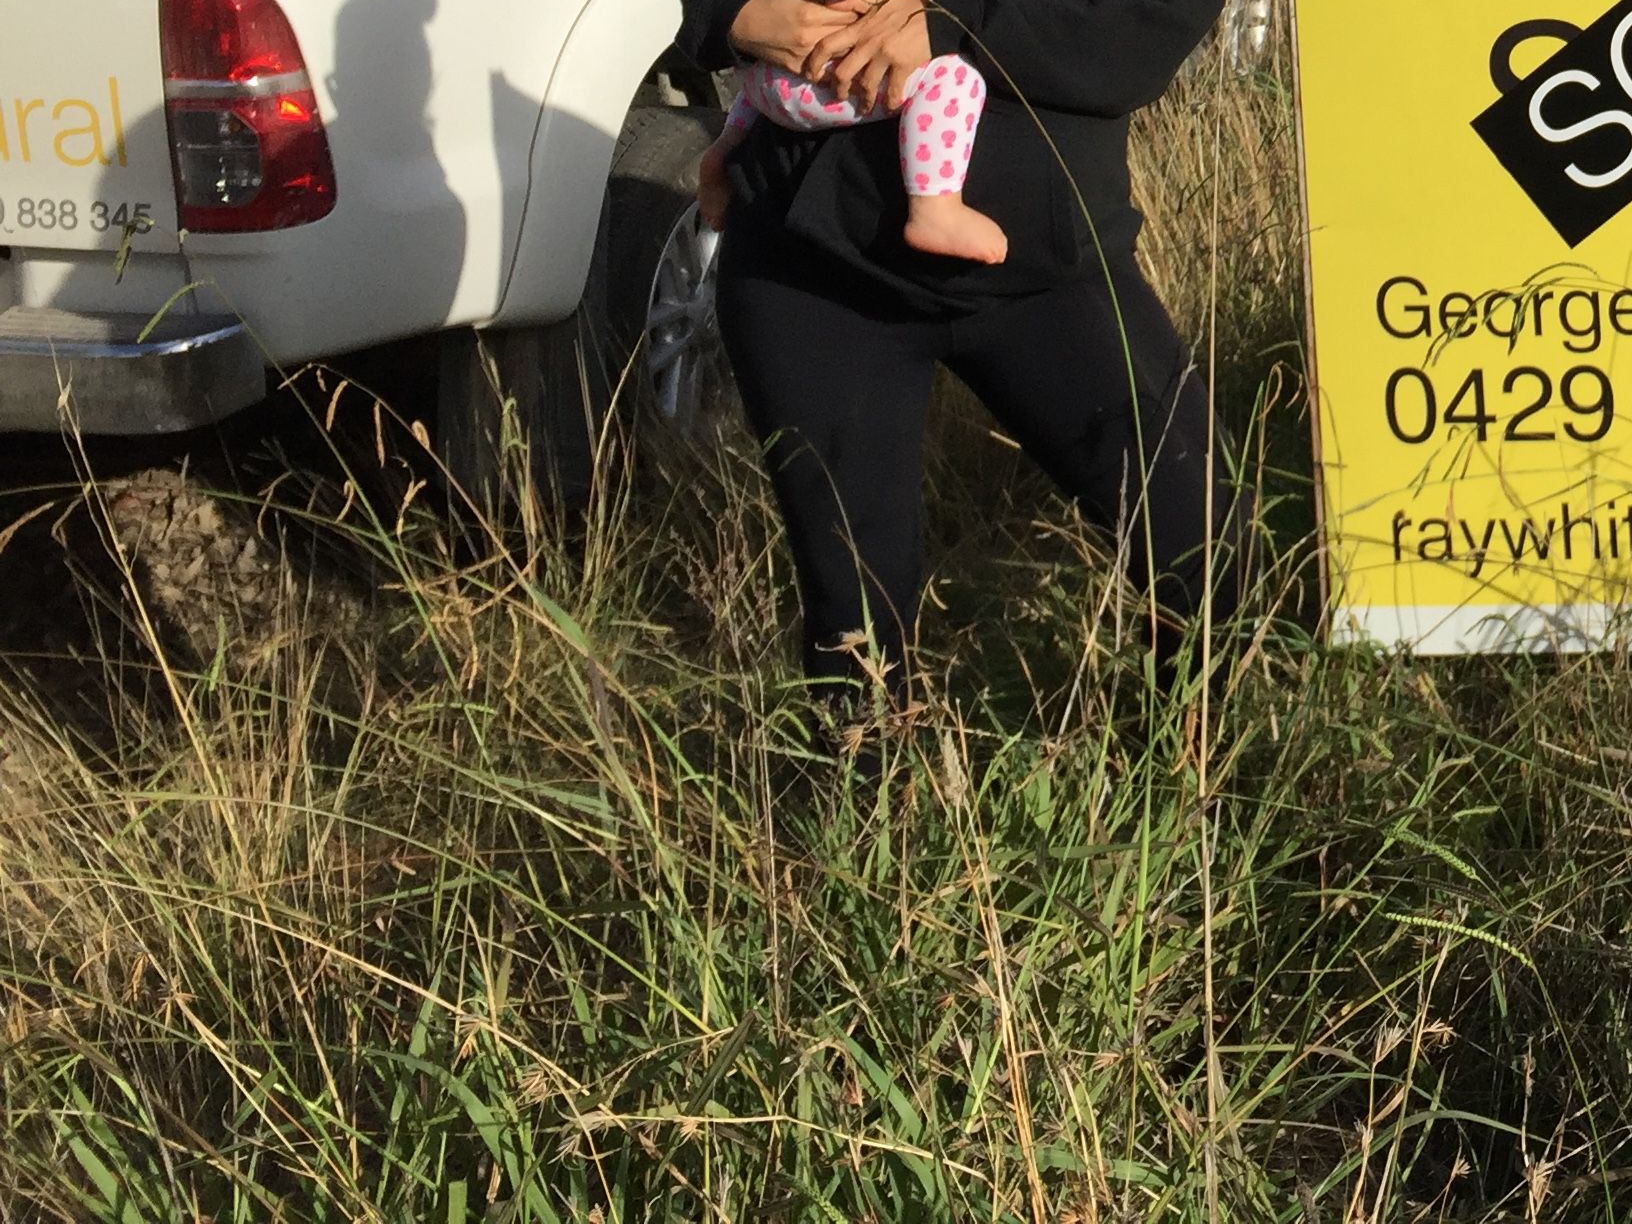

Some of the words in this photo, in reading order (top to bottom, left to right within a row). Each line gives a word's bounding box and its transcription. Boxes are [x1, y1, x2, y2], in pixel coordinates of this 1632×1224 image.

[0, 76, 128, 168] ral
[17, 197, 78, 230] 838
[90, 200, 152, 234] 345
[1384, 365, 1614, 444] 0429
